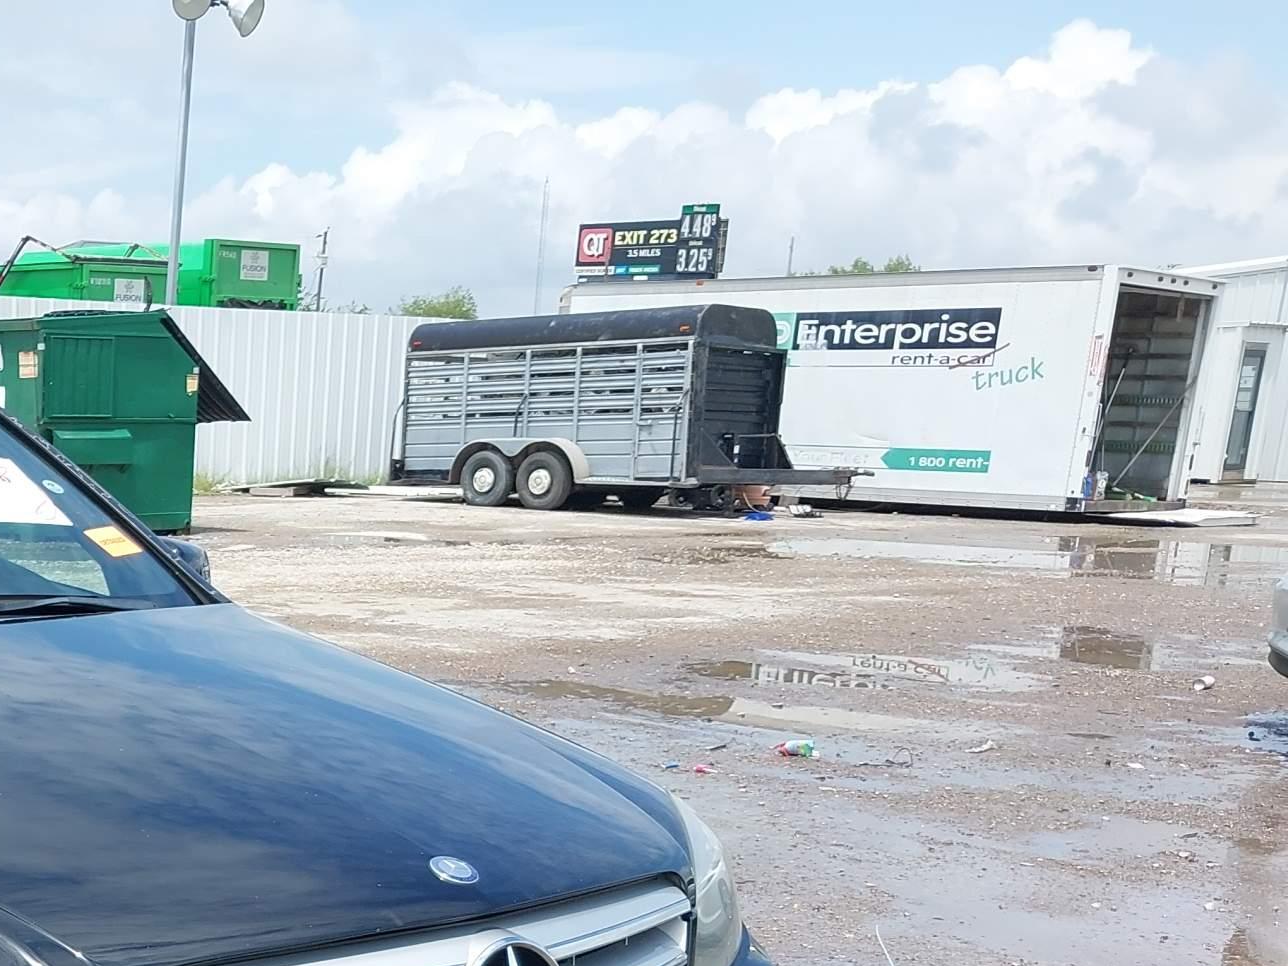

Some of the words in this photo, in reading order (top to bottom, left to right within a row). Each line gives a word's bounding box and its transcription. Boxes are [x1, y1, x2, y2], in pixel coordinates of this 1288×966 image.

[614, 230, 648, 246] EXIT
[648, 228, 678, 245] 273
[582, 233, 609, 257] QT
[638, 248, 661, 257] MILES
[242, 264, 267, 273] FUSION
[115, 294, 142, 303] FUSION
[797, 313, 996, 350] Enterprise
[891, 352, 992, 366] rent-a-car
[971, 357, 1045, 391] truck
[908, 457, 915, 466] 1
[918, 456, 946, 467] 800
